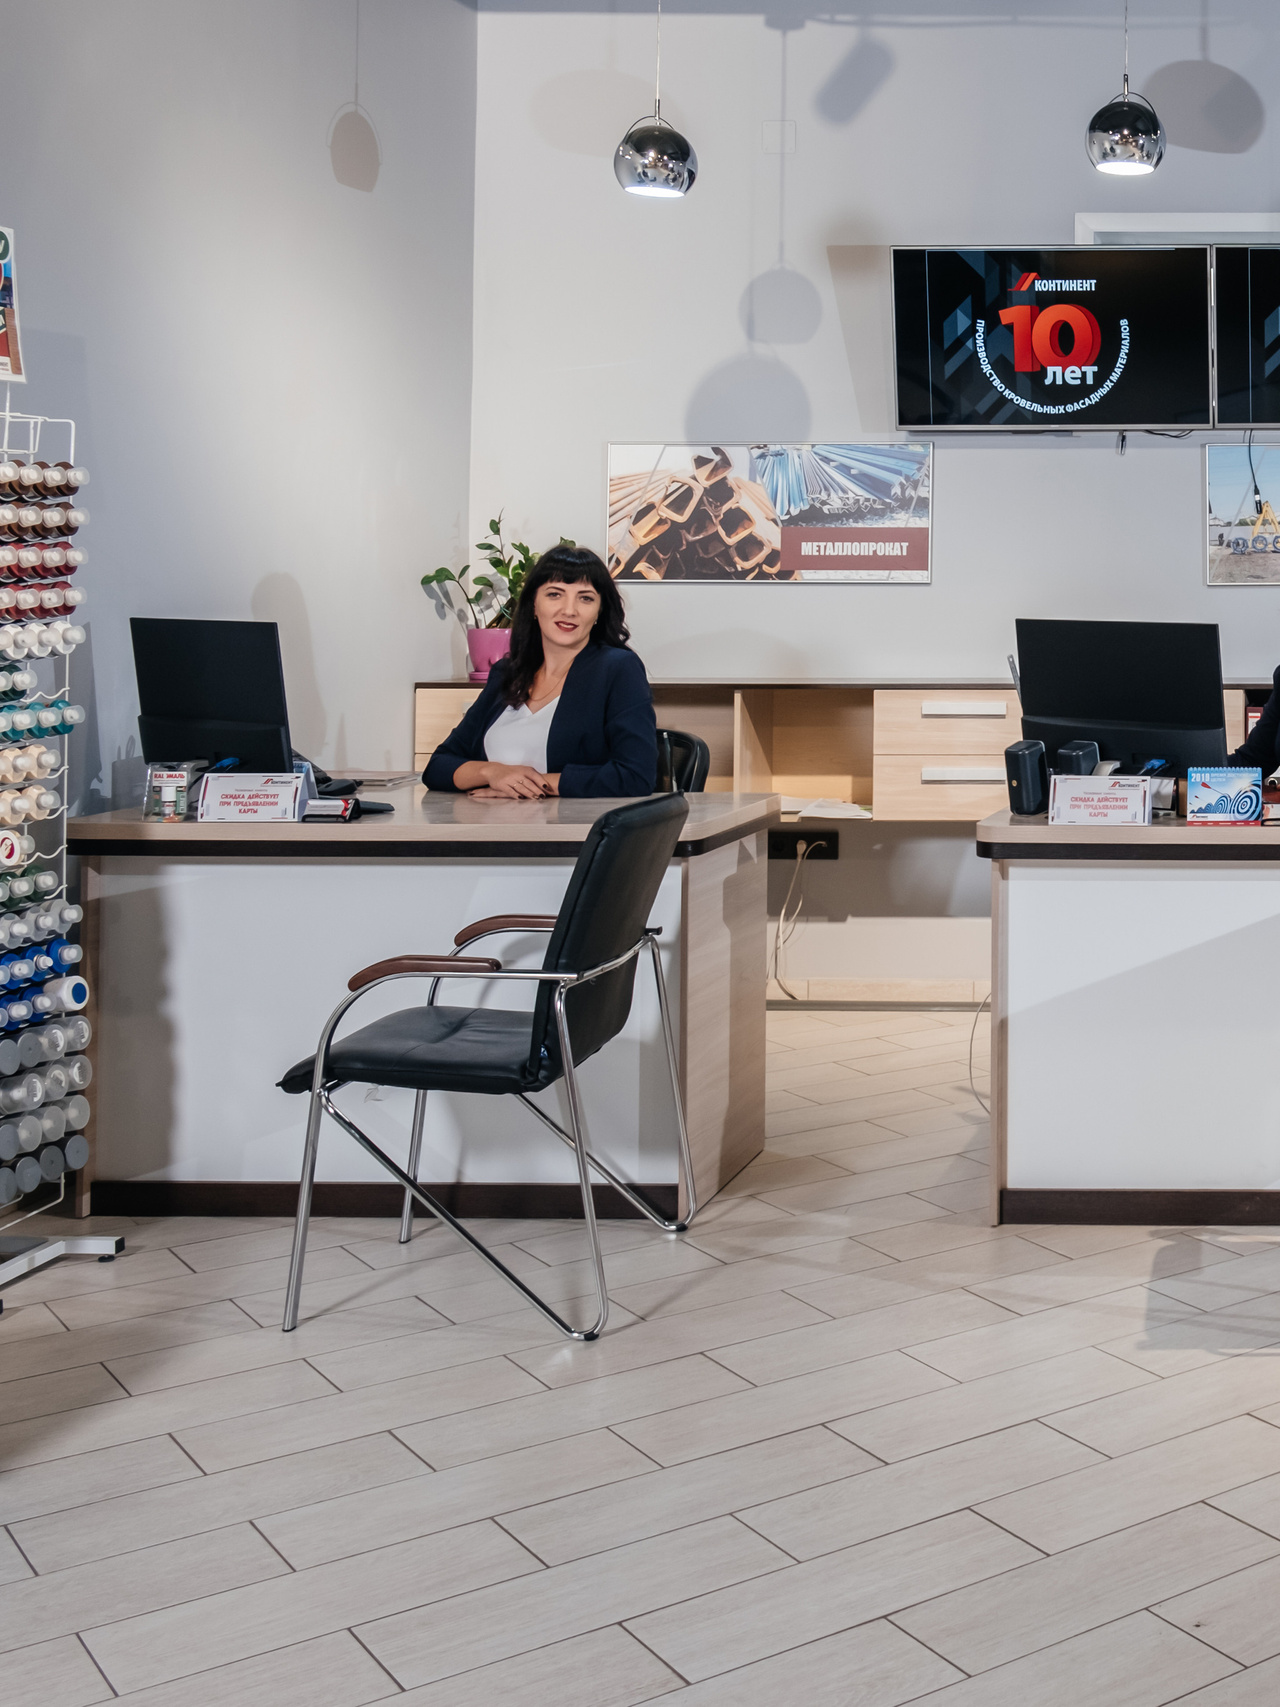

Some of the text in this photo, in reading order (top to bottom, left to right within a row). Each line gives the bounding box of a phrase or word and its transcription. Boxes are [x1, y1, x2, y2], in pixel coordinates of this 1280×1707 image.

[1034, 279, 1097, 292] КОНТИНЕНТ
[998, 303, 1102, 373] 10
[975, 318, 1131, 414] ПРОИЗВОДСТВО КРОВЕЛЬНЫХ ФАСАДНЫХ МАТЕРИАЛОВ
[1044, 365, 1098, 385] лет
[801, 541, 909, 557] МЕТАЛЛОПРОКАТ
[247, 792, 280, 800] ДЕЙСТВУЕТ
